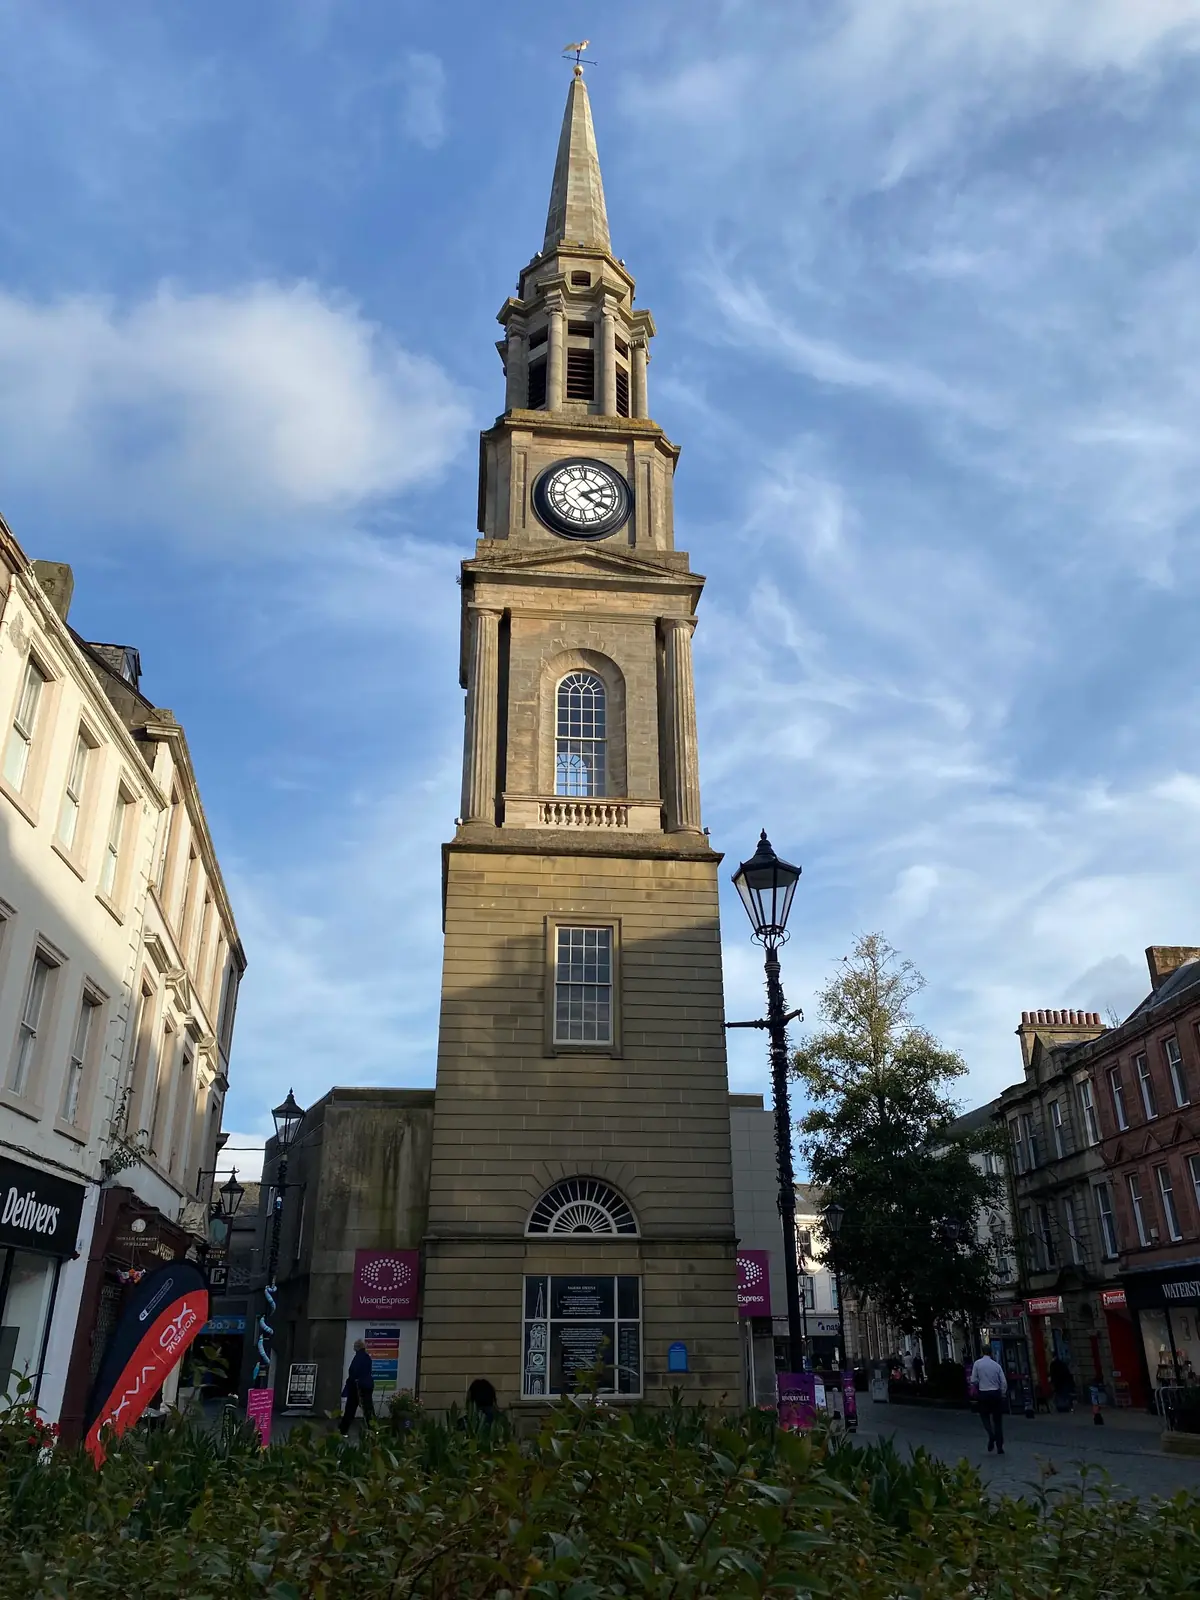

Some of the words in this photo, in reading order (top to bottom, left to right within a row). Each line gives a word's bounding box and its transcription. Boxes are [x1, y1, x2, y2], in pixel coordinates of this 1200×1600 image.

[1, 1186, 61, 1236] Delivers
[737, 1294, 765, 1304] Express
[1161, 1280, 1200, 1299] WATERST
[359, 1296, 410, 1305] VisionExpress
[166, 1312, 197, 1354] PASSION
